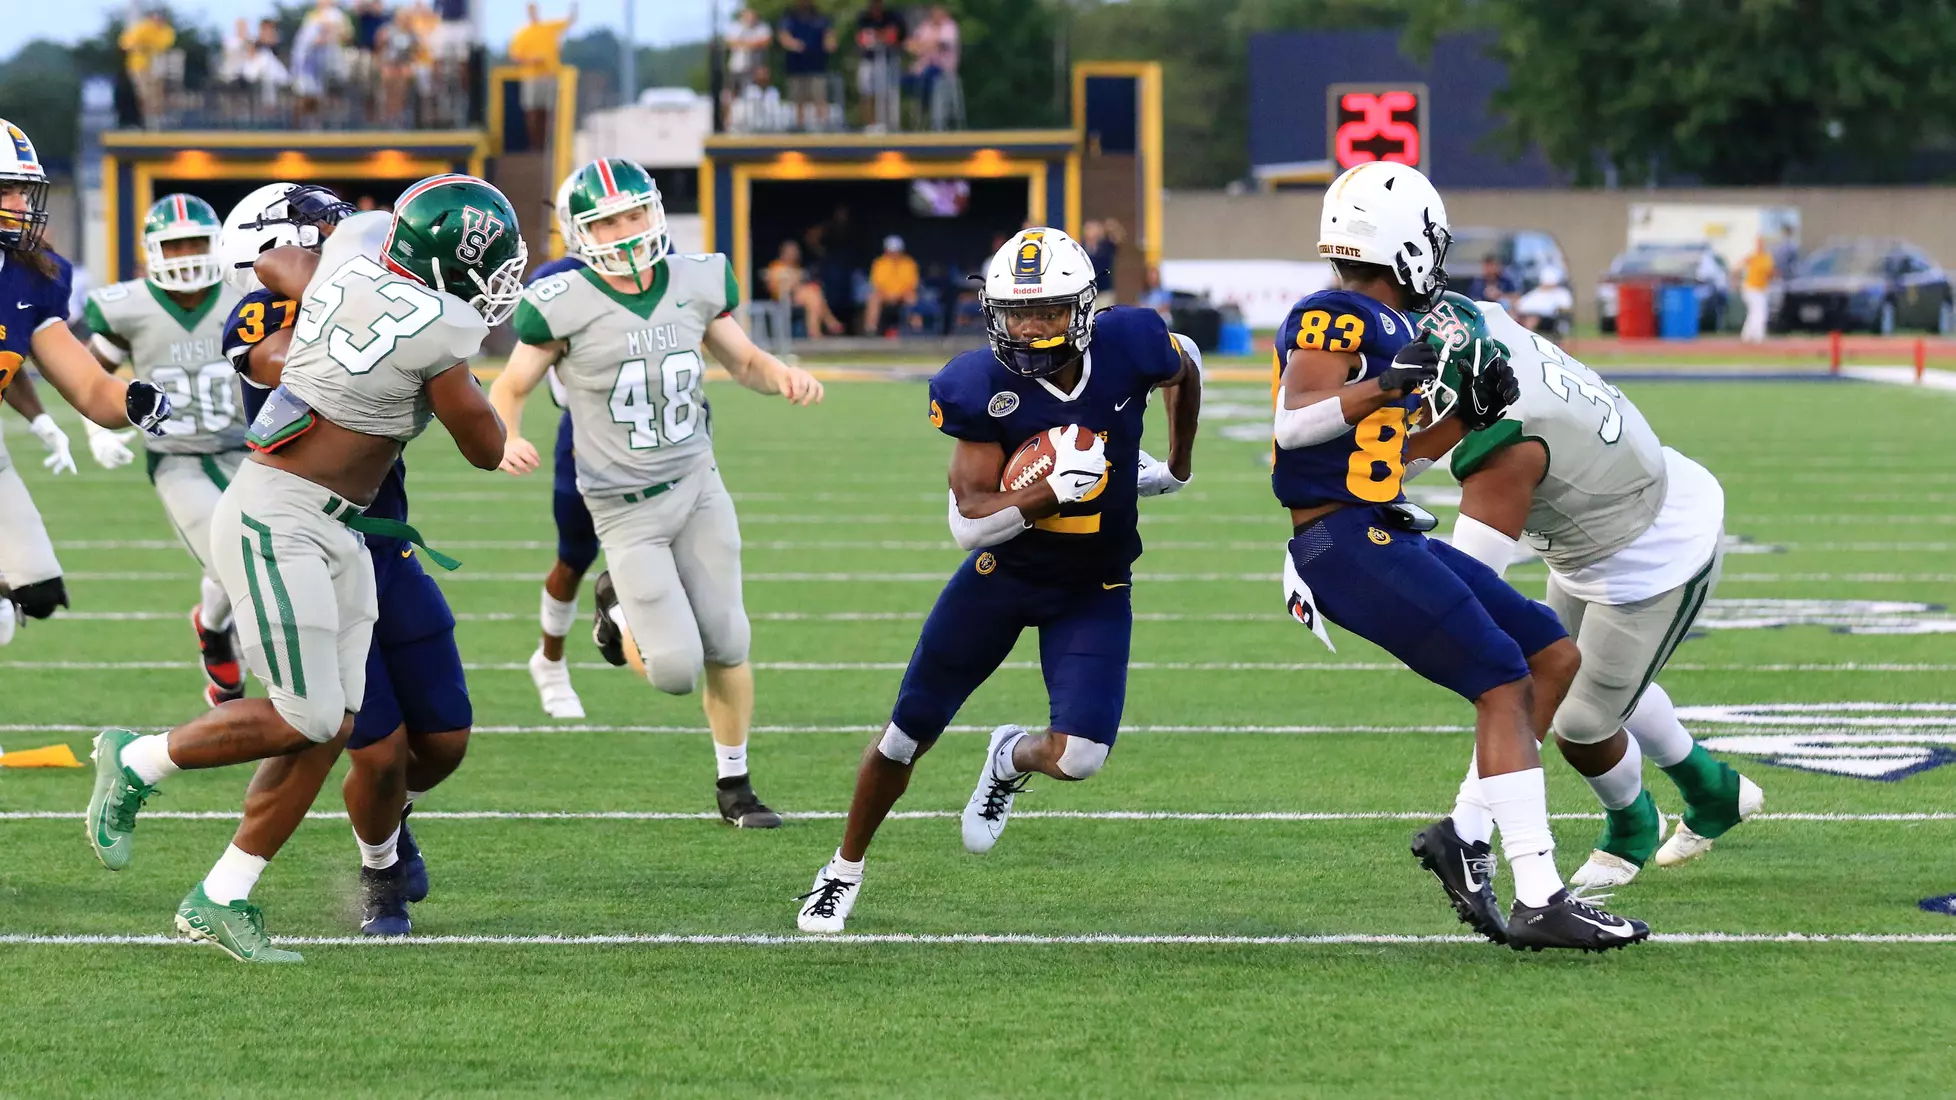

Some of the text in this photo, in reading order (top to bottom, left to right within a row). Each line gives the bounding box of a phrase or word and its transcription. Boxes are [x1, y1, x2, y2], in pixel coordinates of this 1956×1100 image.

[1336, 92, 1419, 169] 25
[1335, 245, 1361, 258] STATE
[1013, 287, 1042, 295] Riddell
[237, 300, 298, 343] 37
[296, 254, 444, 376] 53
[1296, 310, 1364, 352] 83
[171, 337, 215, 363] MVSU
[626, 324, 679, 356] MVSU
[151, 360, 237, 434] 20
[607, 349, 701, 450] 48
